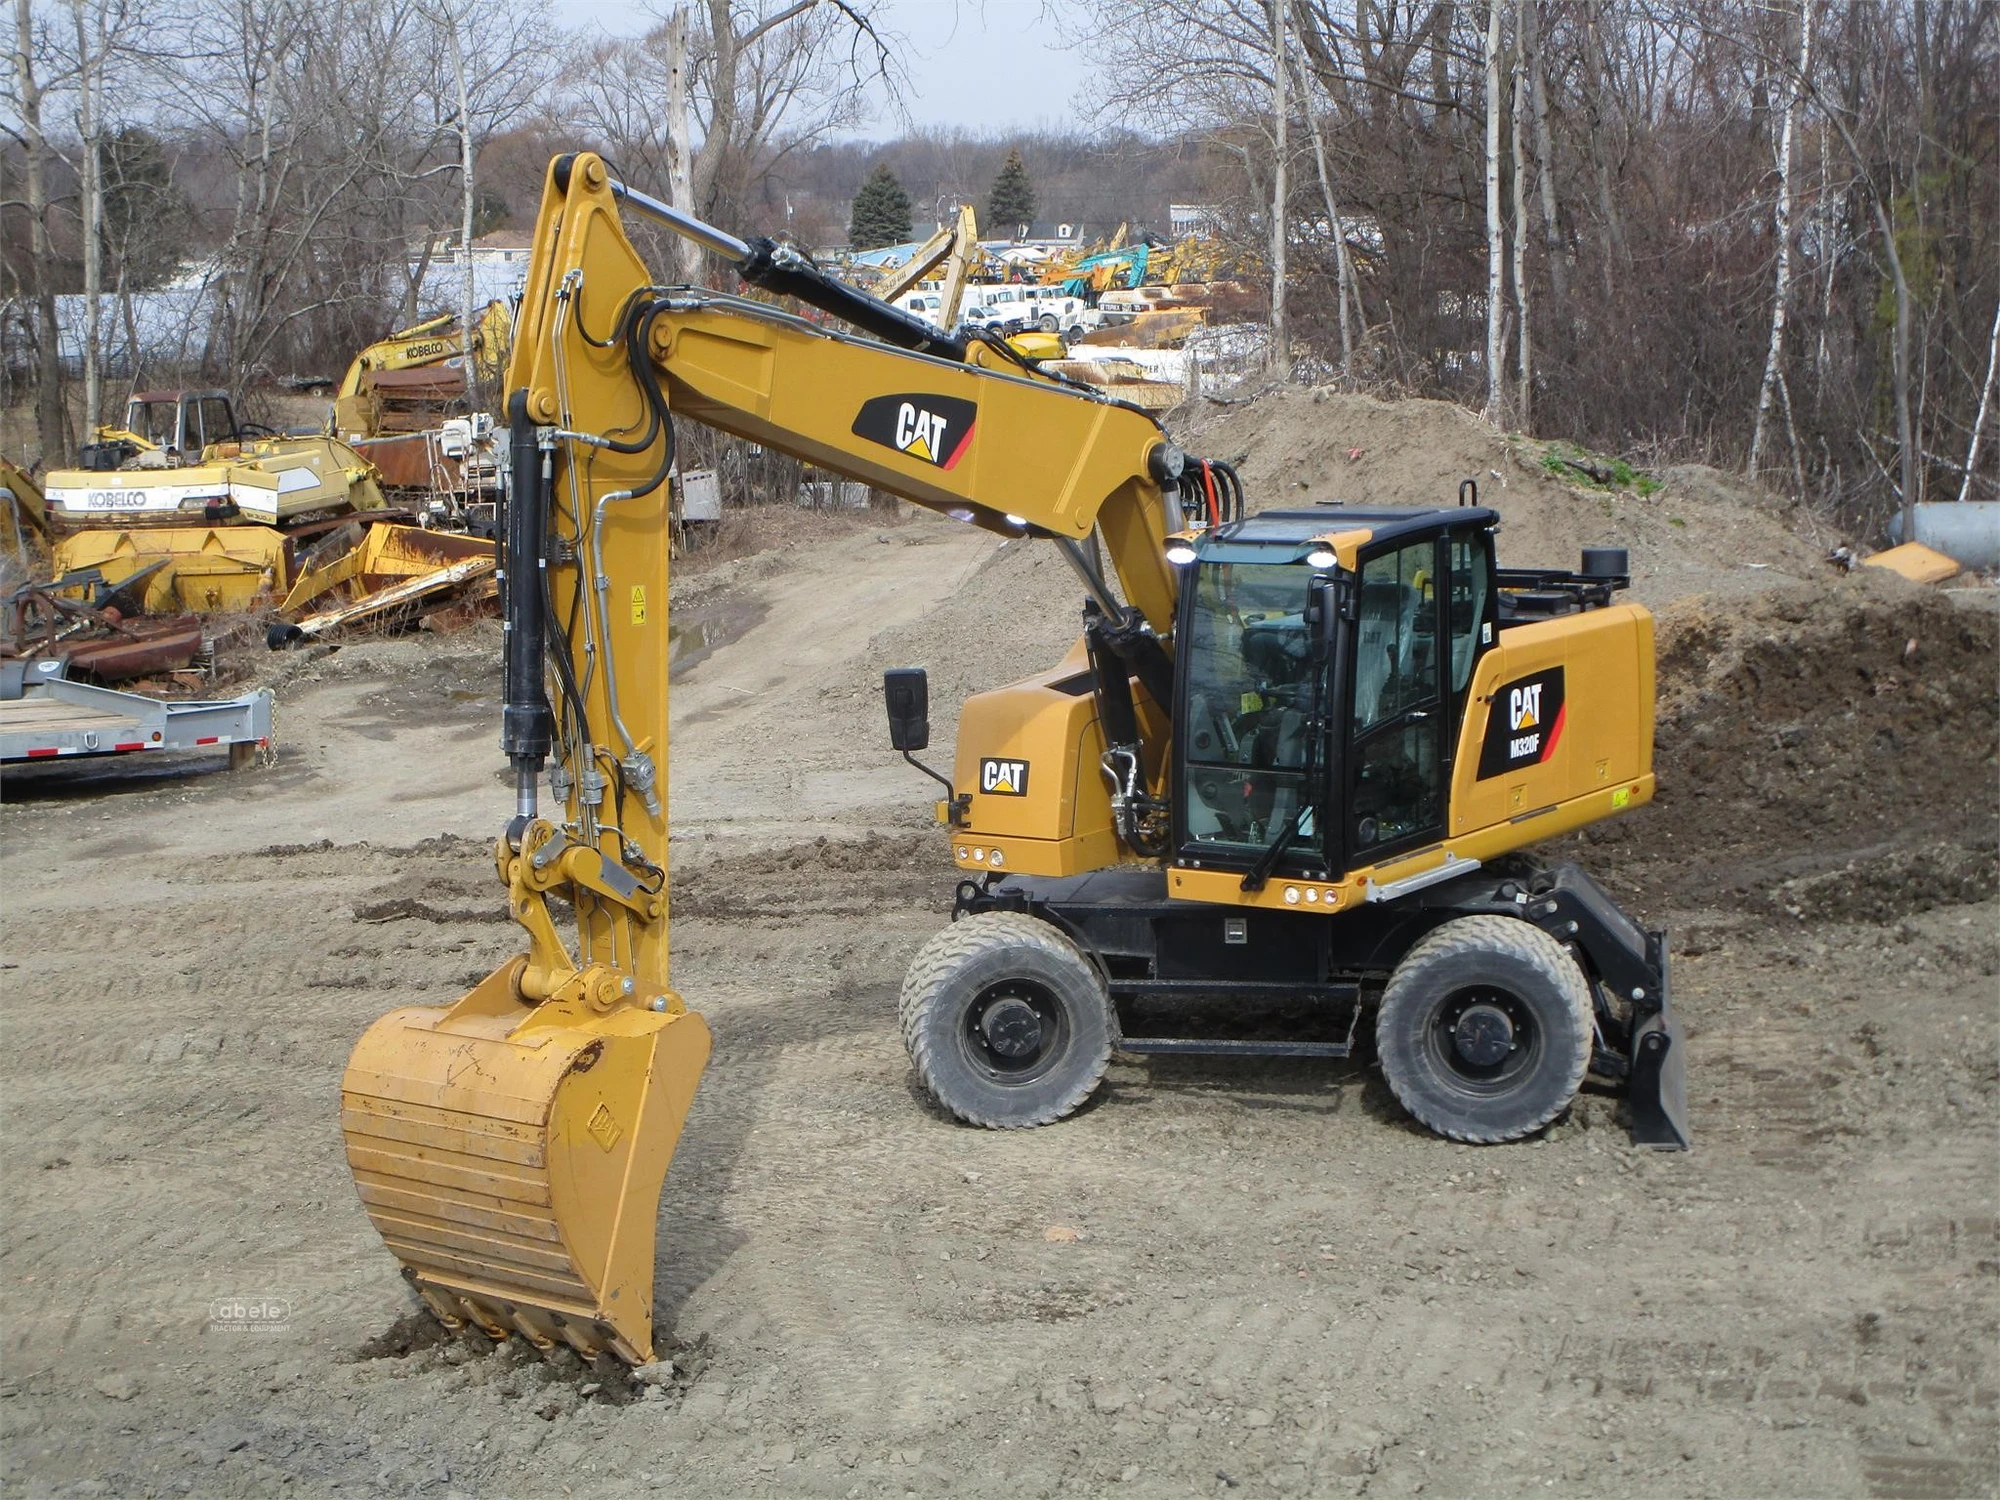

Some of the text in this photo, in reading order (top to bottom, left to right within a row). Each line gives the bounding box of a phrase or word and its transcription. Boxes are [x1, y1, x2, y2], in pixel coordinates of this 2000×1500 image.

[406, 342, 443, 360] KOBELCO
[896, 402, 948, 463] CAT
[87, 491, 147, 508] KOBELCO
[1510, 683, 1542, 730] CAT
[1510, 733, 1540, 758] M320F
[984, 761, 1025, 793] CAT
